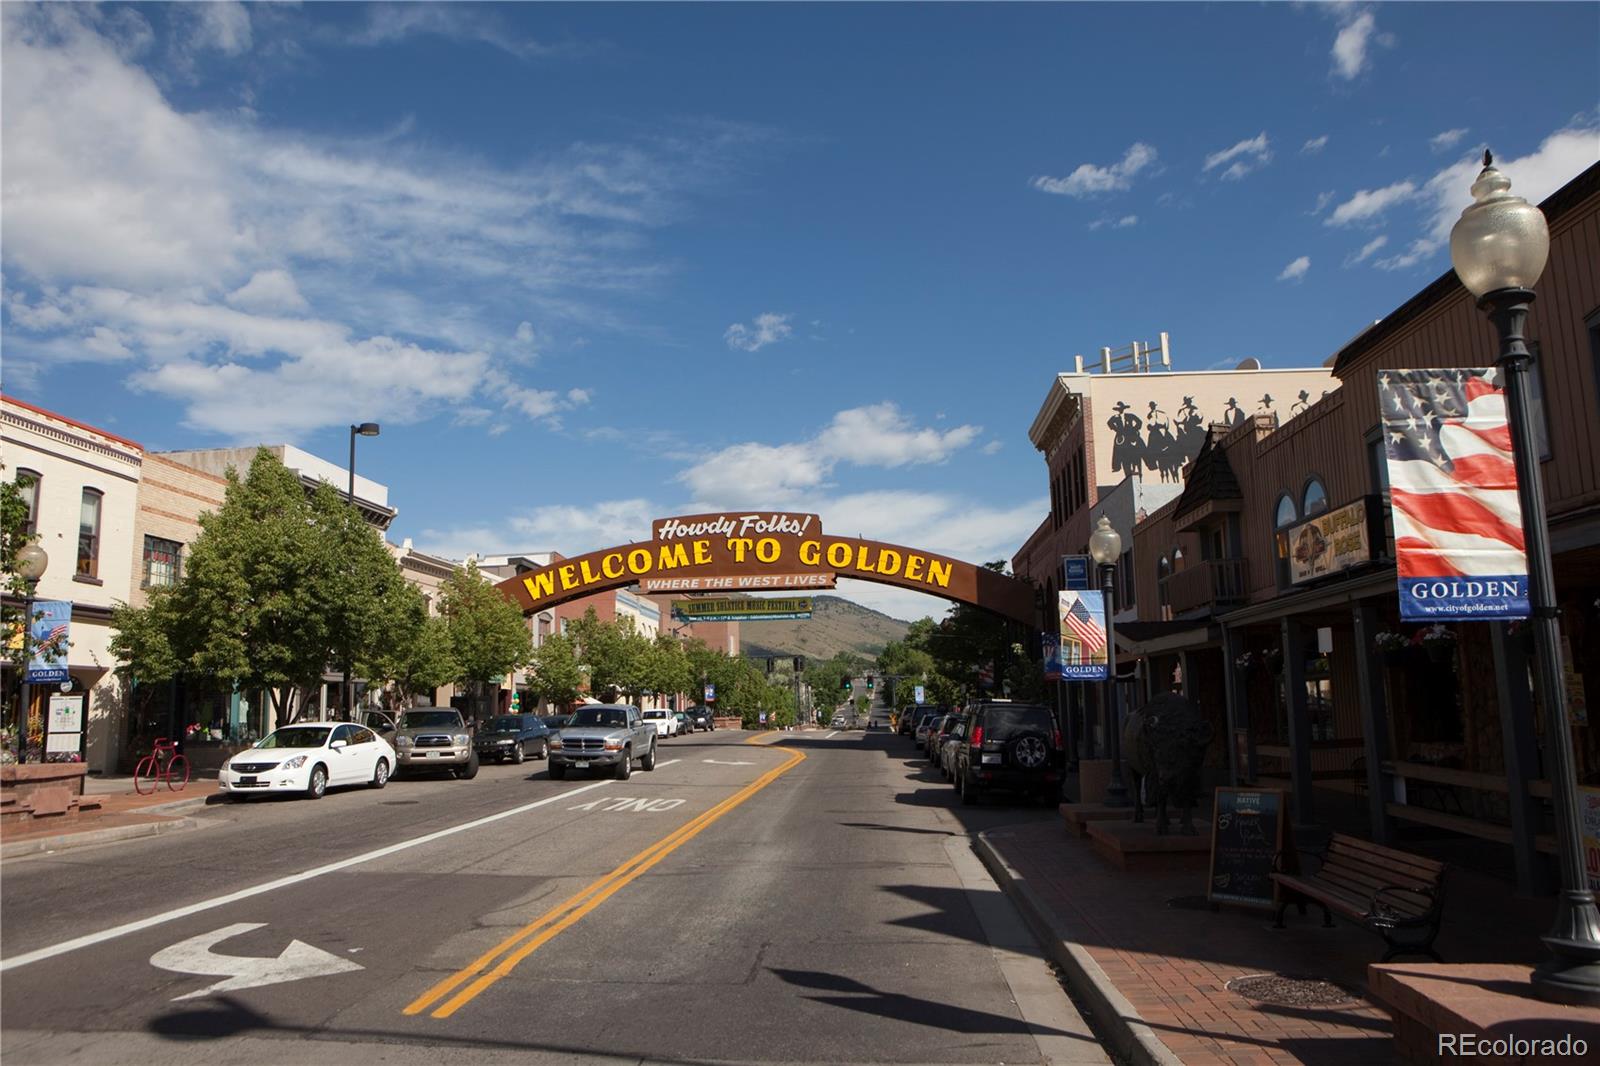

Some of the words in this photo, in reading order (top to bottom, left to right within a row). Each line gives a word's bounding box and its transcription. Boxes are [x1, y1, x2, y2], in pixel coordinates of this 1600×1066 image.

[659, 516, 737, 540] Howdy
[739, 515, 812, 537] Folks!
[1322, 503, 1364, 537] BUFFALO
[1334, 532, 1361, 557] ROSE
[523, 540, 713, 601] WELCOME
[727, 537, 782, 564] TO
[799, 541, 953, 588] GOLDEN
[647, 578, 700, 589] WHERE
[705, 578, 734, 588] THE
[739, 577, 782, 587] WEST
[785, 575, 828, 586] LIVES
[1411, 580, 1519, 600] GOLDEN
[688, 602, 715, 612] SUMMER
[1425, 603, 1509, 614] www.cityofgolden.net
[1065, 665, 1104, 673] GOLDEN
